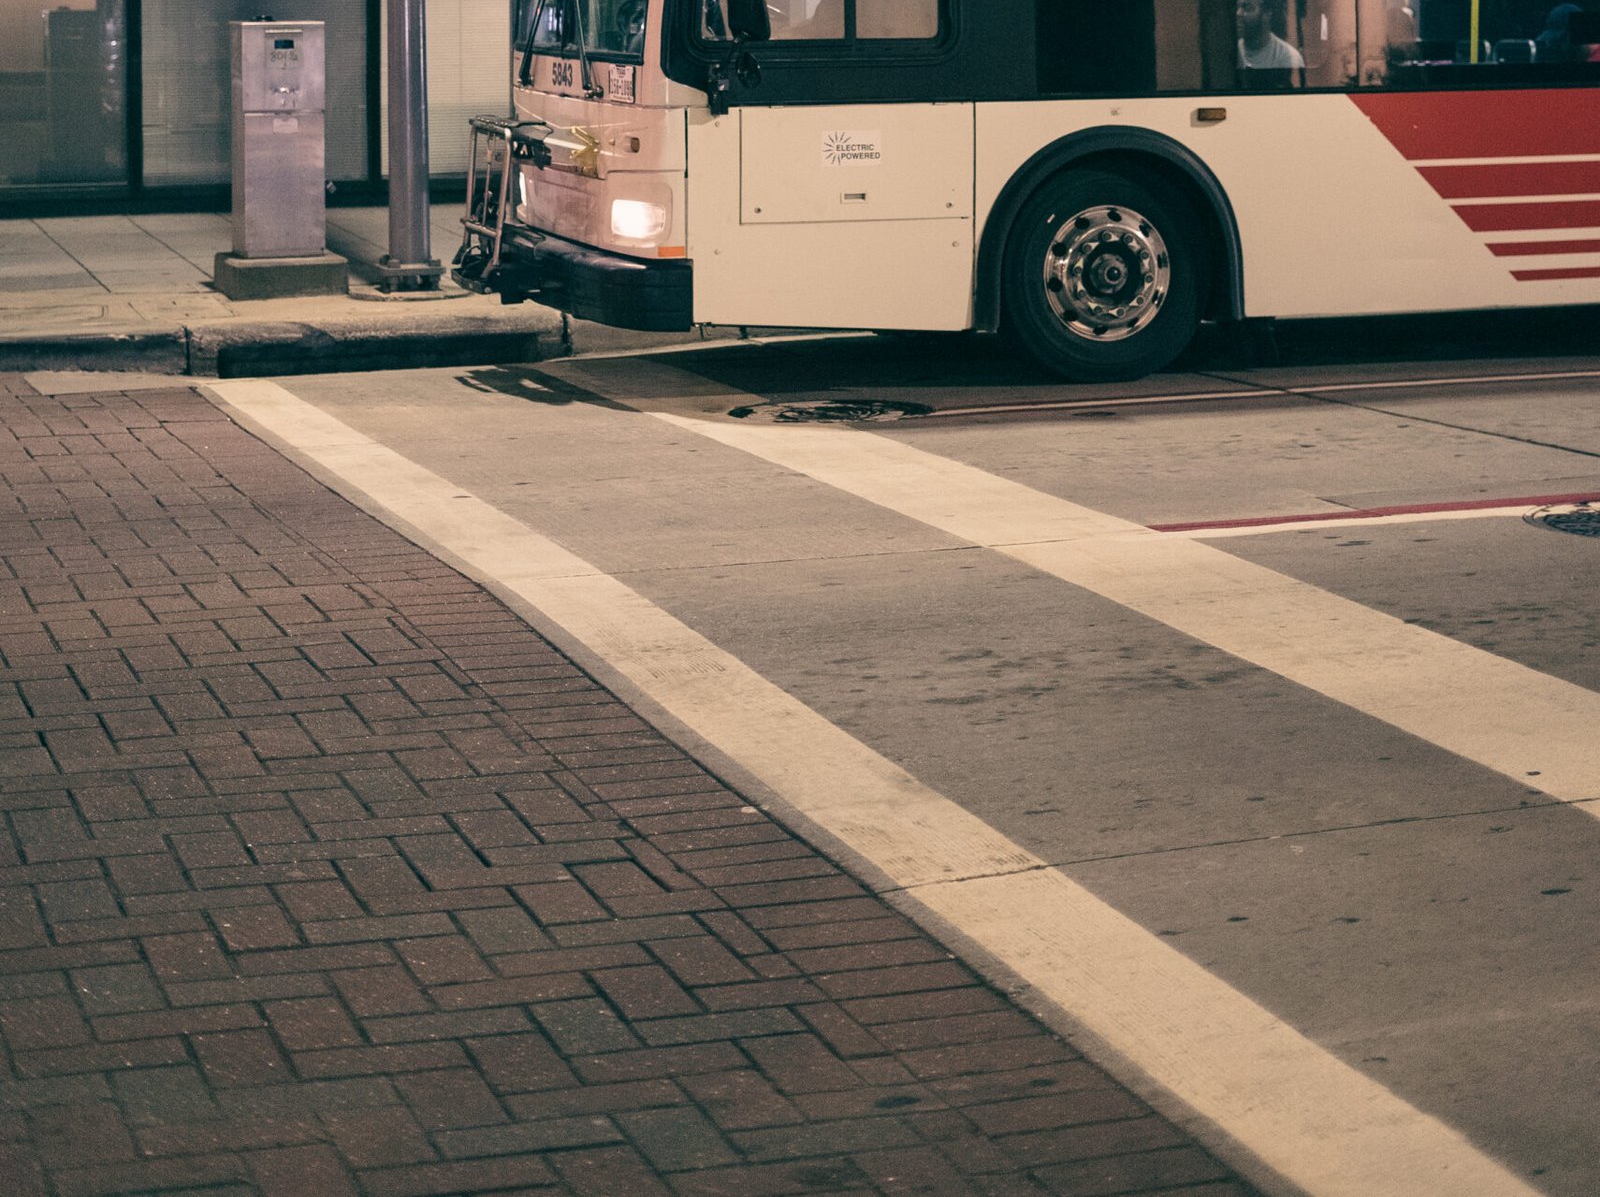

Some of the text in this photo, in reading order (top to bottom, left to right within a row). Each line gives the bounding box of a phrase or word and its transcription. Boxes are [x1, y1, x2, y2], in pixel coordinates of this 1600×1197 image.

[552, 62, 573, 87] 5843
[836, 144, 875, 152] ELECTRIC
[841, 152, 881, 160] POWERED
